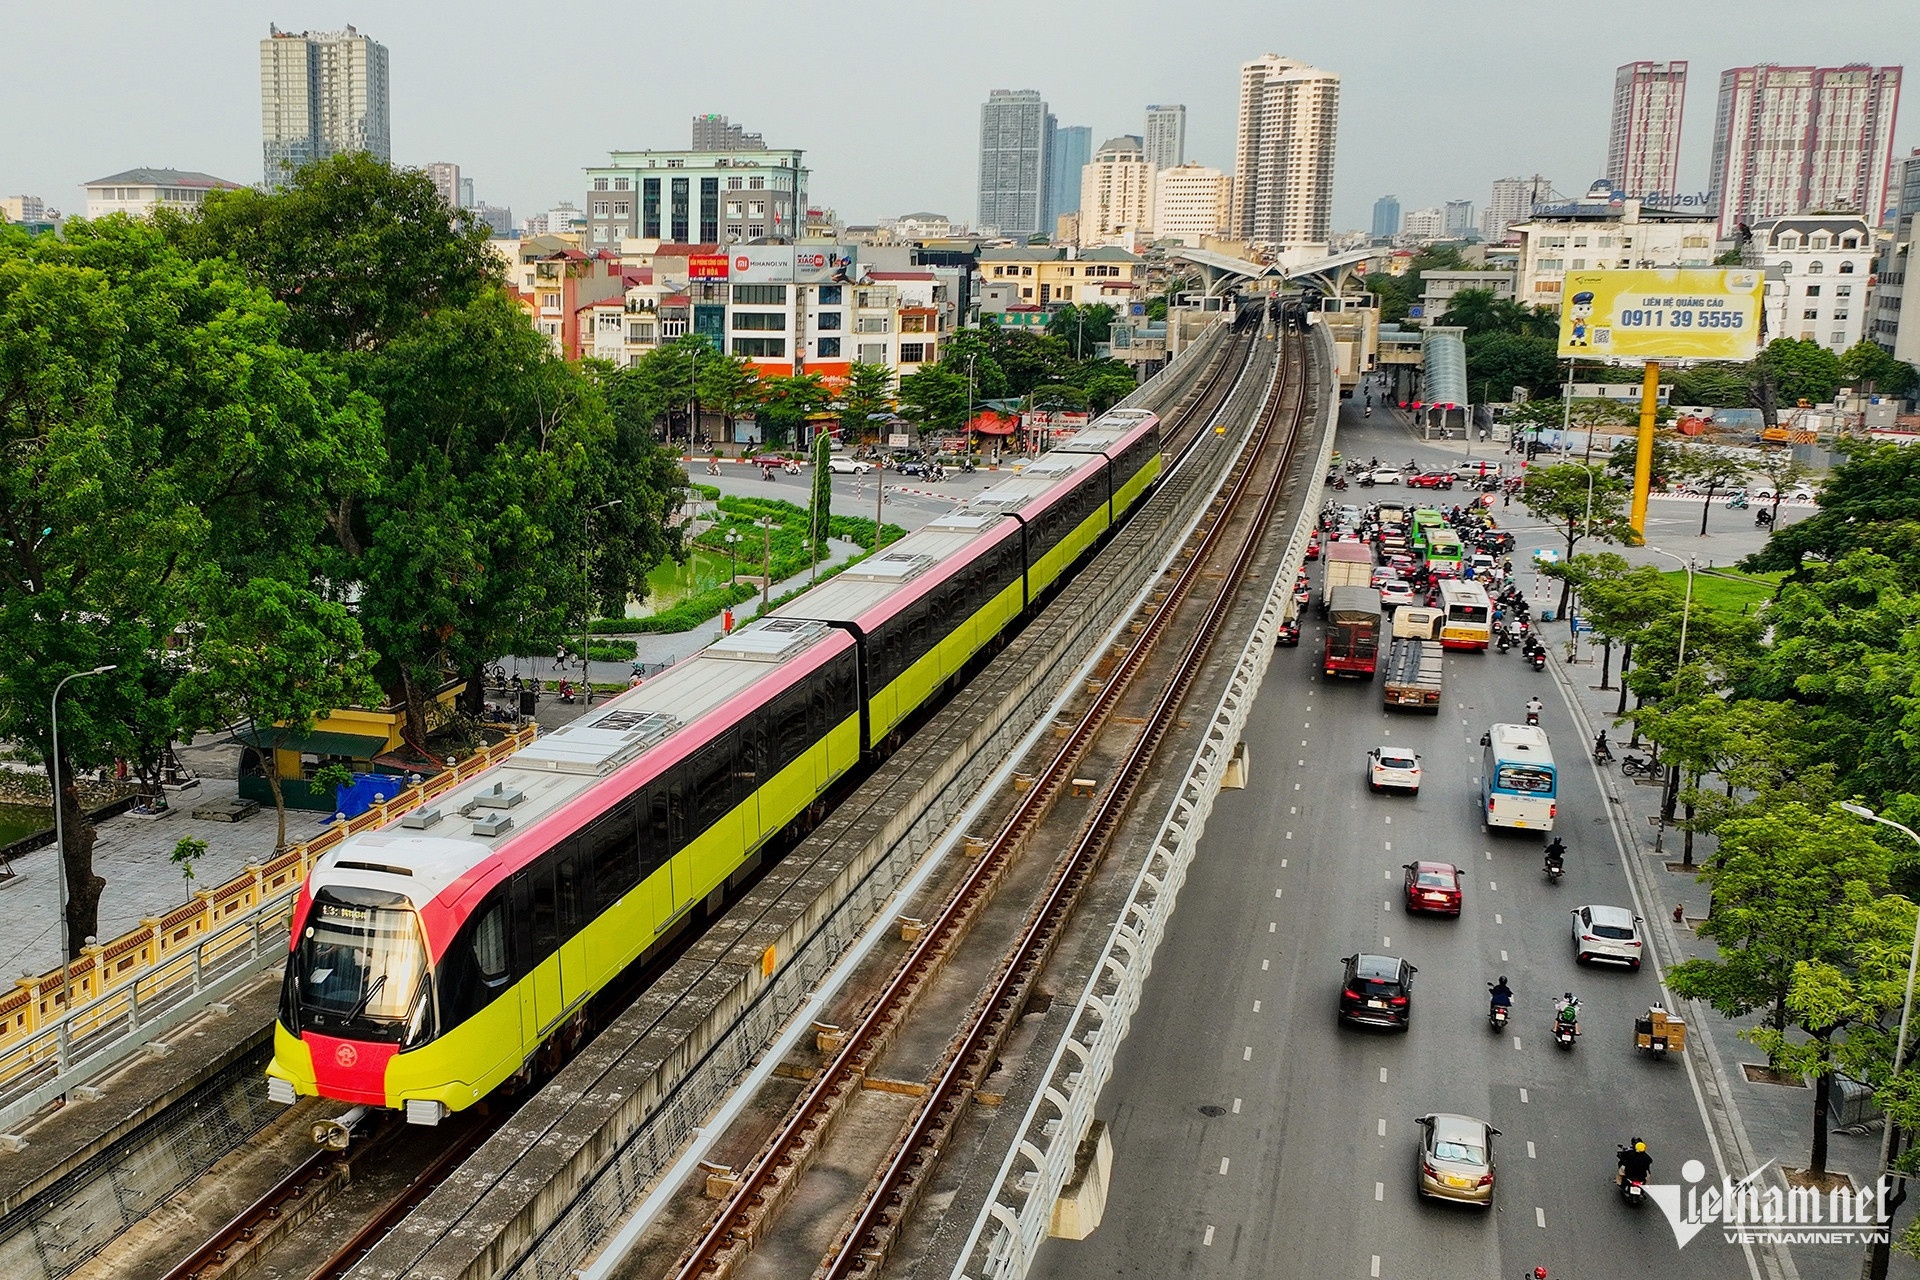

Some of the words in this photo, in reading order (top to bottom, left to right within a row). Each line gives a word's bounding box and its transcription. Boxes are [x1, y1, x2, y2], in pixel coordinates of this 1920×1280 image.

[1642, 297, 1661, 307] LIÊN
[1662, 297, 1674, 308] HỆ
[1675, 297, 1705, 308] QUẢNG
[1706, 297, 1724, 307] CÁO
[1621, 309, 1663, 327] 0911
[1669, 310, 1693, 327] 39
[1697, 310, 1744, 328] 5555
